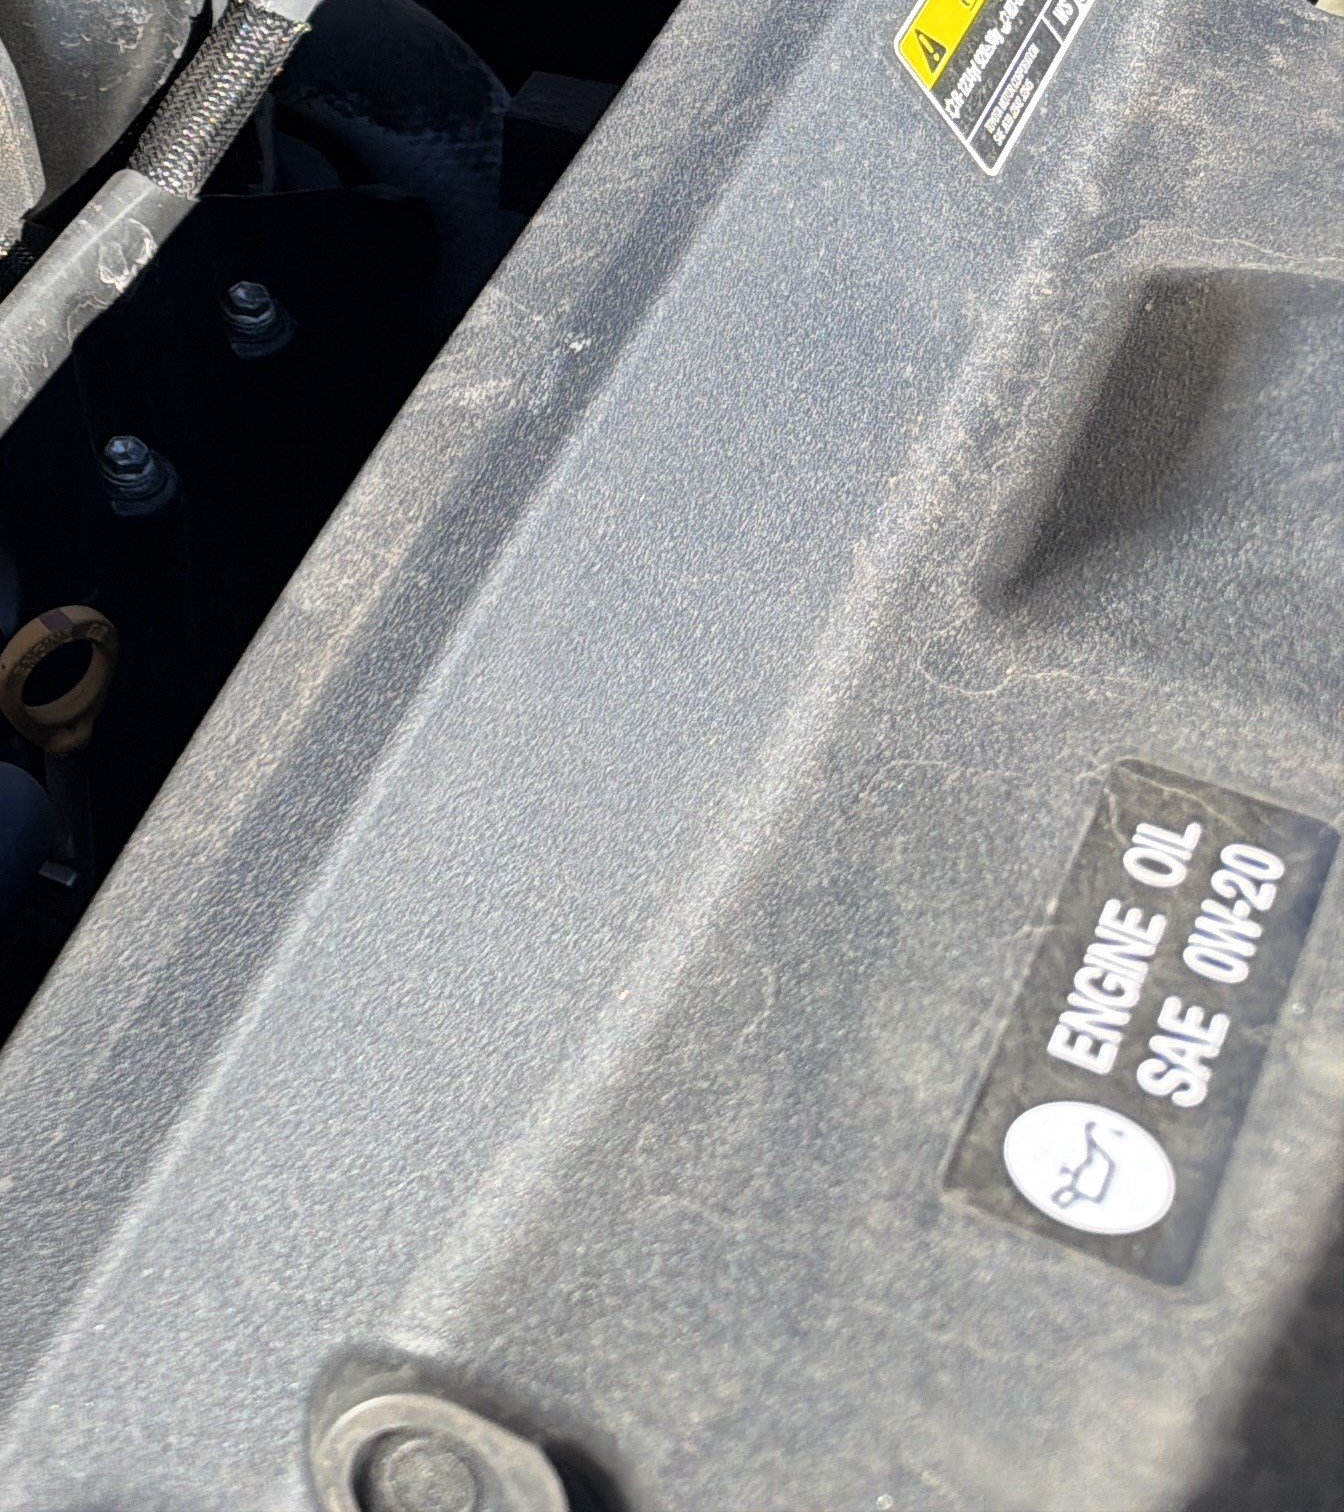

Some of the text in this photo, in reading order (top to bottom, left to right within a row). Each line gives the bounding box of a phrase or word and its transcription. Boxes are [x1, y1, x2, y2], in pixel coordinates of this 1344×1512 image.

[1047, 822, 1202, 1076] ENGINE OIL
[1136, 843, 1287, 1109] SAE 0W-20
